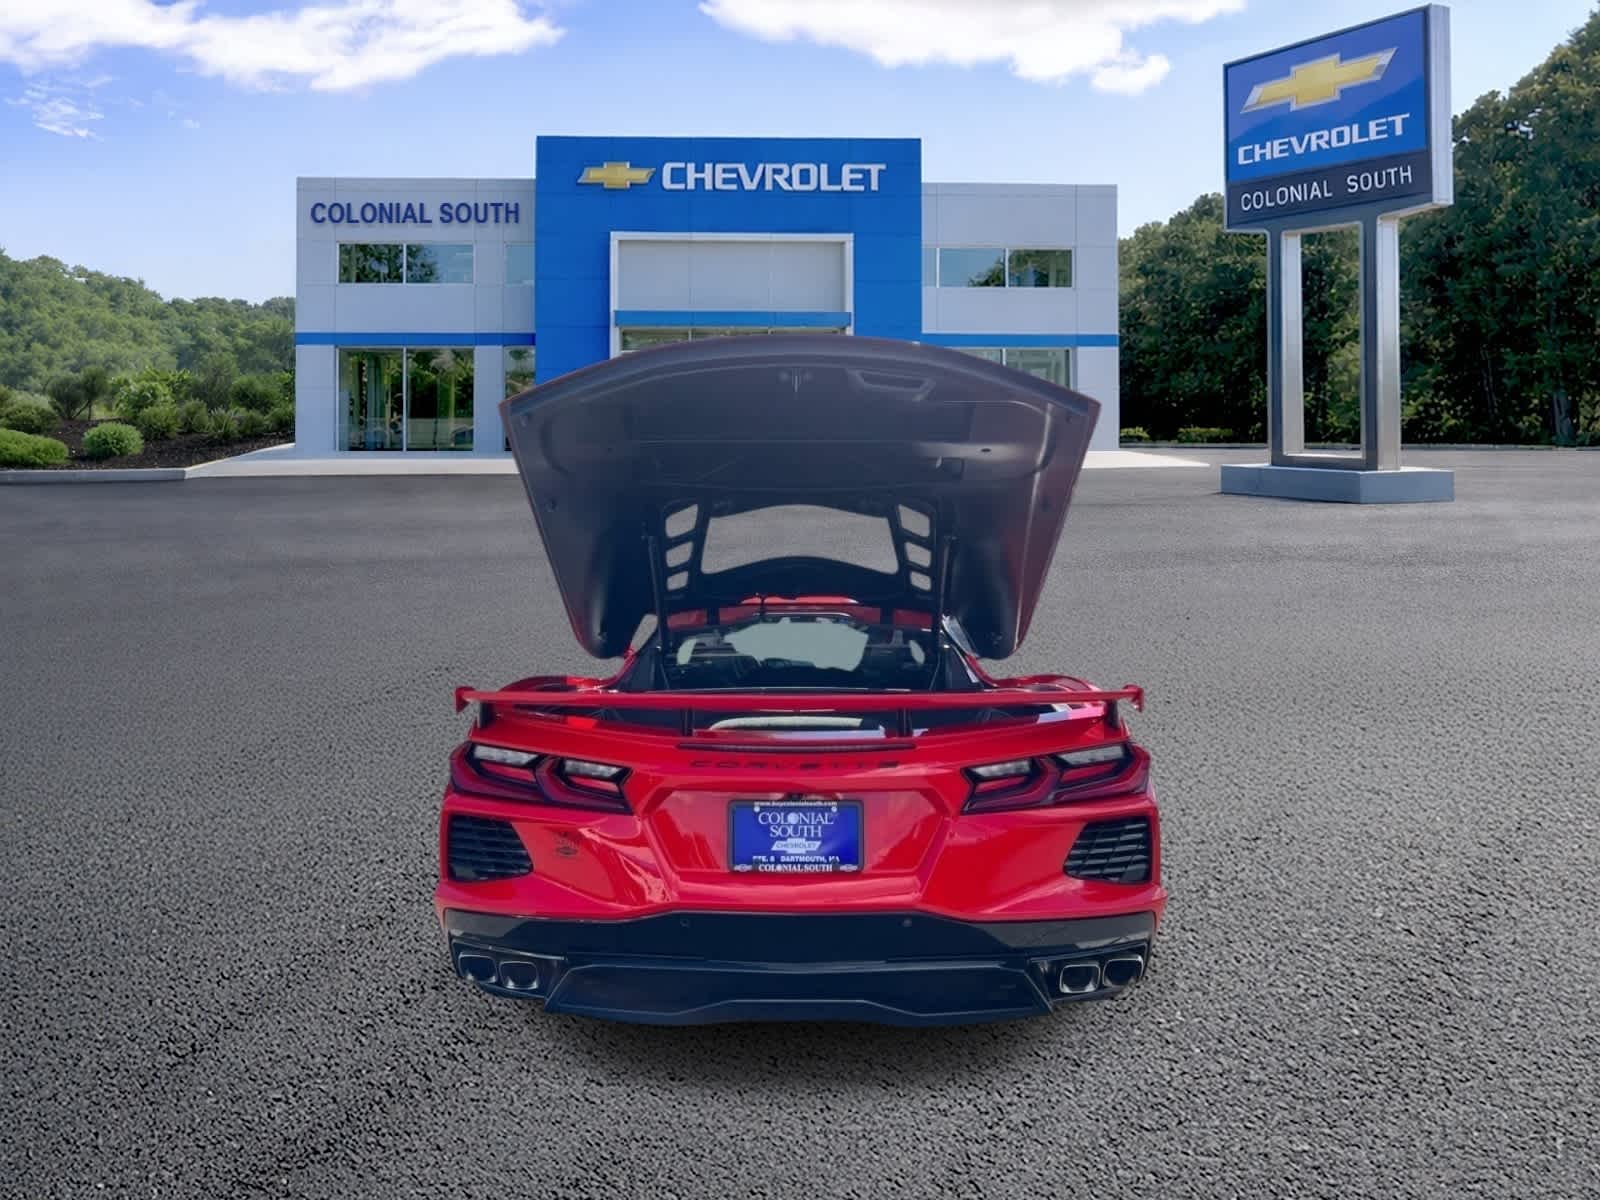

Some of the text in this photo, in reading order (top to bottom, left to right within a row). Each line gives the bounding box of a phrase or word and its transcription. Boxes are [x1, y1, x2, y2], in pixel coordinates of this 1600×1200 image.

[1237, 113, 1410, 165] CHEVROLET
[661, 162, 886, 192] CHEVROLET
[1240, 165, 1413, 211] COLONIAL SOUTH
[310, 202, 521, 225] COLONIAL SOUTH
[758, 811, 835, 825] COLONIAL
[769, 825, 822, 838] SOUTH
[776, 841, 817, 849] CHEVROLET
